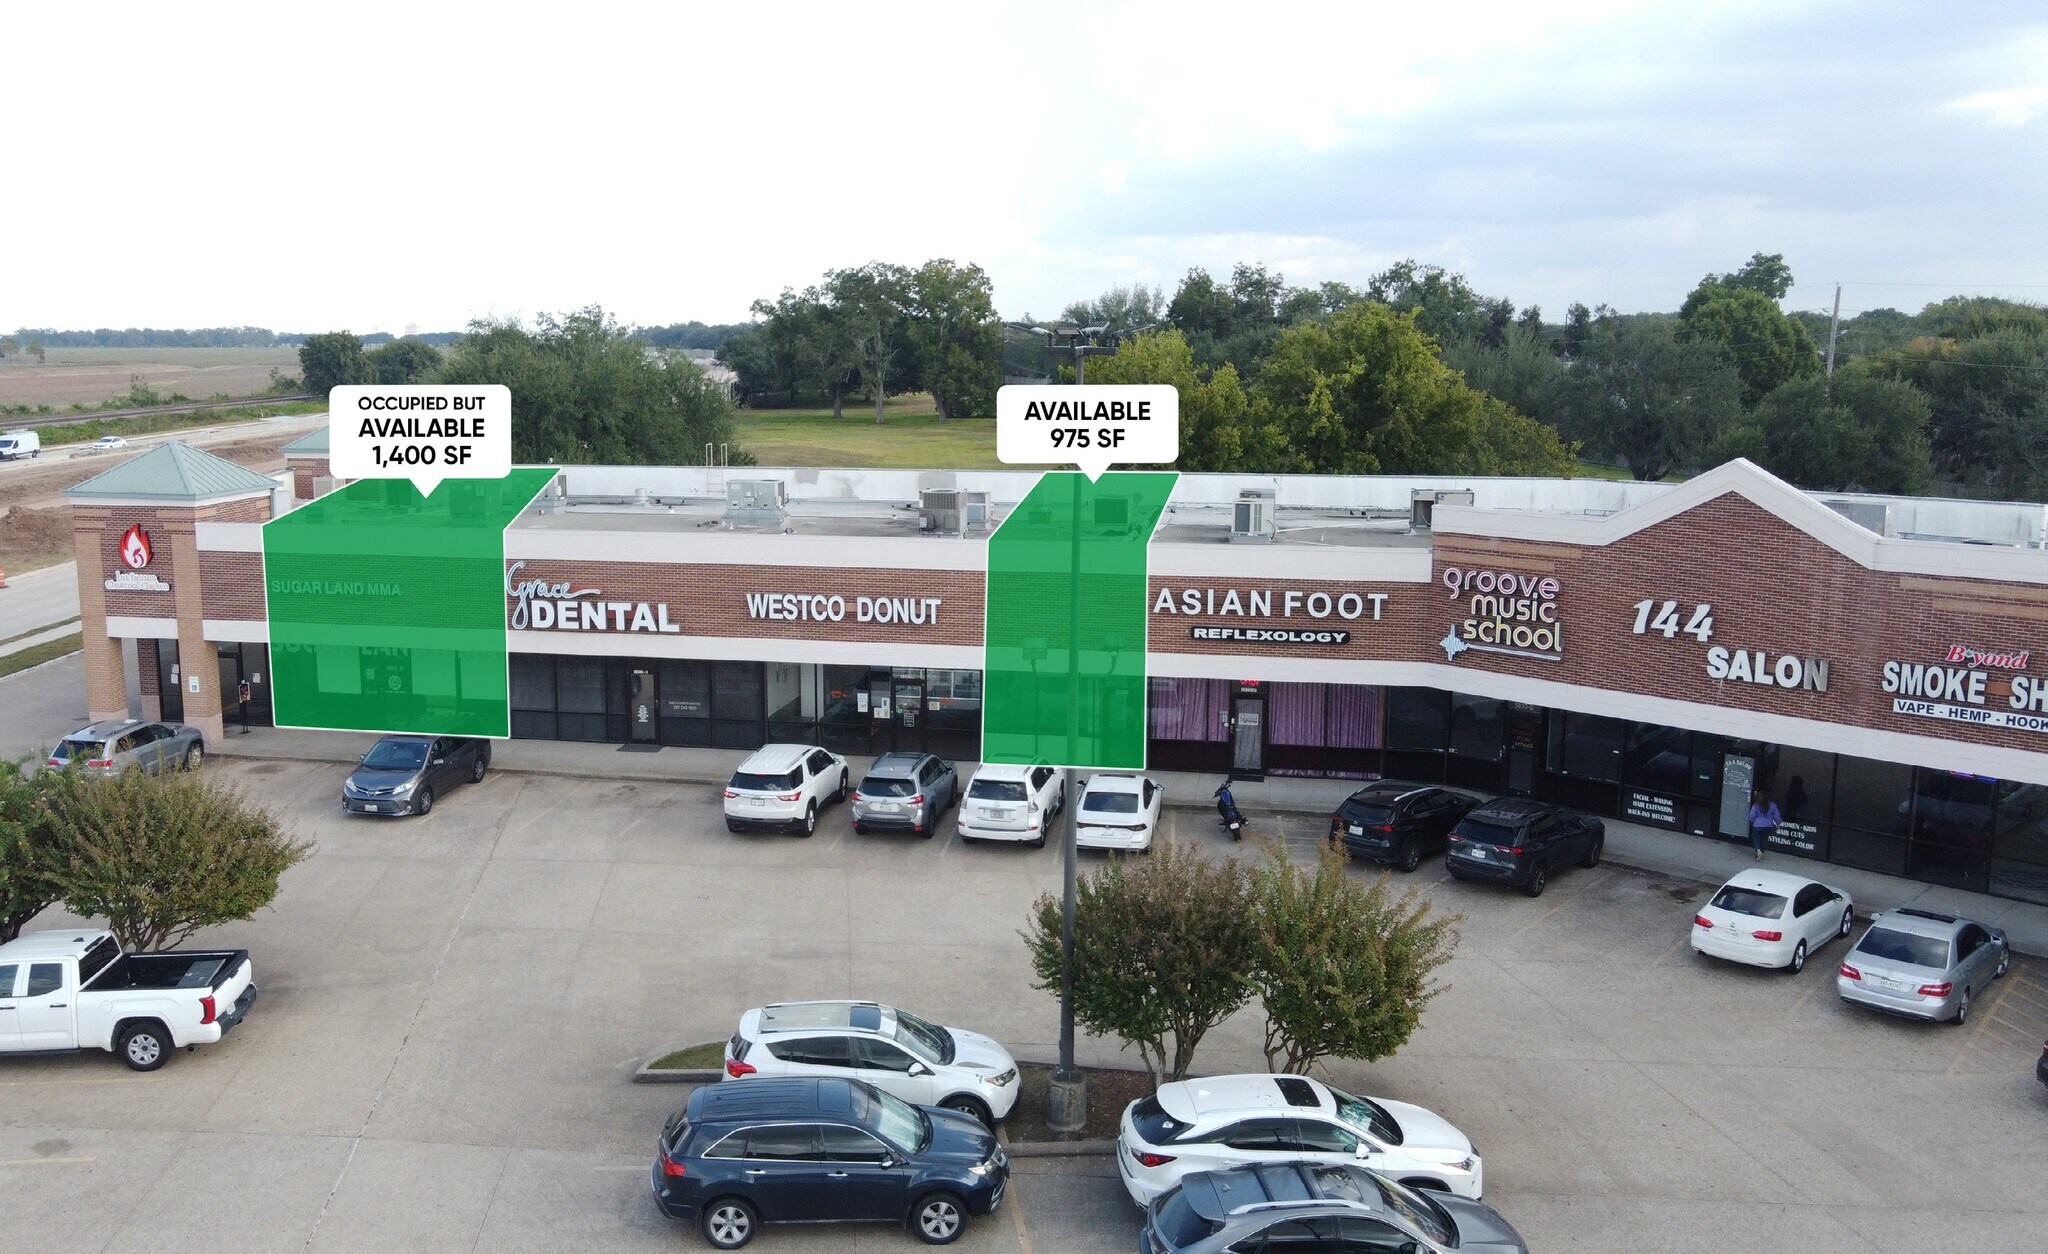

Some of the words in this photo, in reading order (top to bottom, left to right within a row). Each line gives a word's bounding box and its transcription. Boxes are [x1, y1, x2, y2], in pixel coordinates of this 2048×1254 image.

[271, 580, 322, 594] SUGAR
[325, 581, 364, 595] LAND
[367, 583, 402, 596] MMA
[506, 561, 600, 629] Grace
[1443, 567, 1560, 599] groove
[531, 600, 680, 632] DENTAL
[746, 593, 846, 622] WESTCO
[857, 597, 942, 624] DONUT
[1153, 587, 1271, 617] ASIAN
[1284, 591, 1388, 620] FOOT
[1471, 592, 1557, 623] music
[1193, 628, 1347, 643] REFLEXOLOGY
[1463, 615, 1562, 652] school
[1632, 600, 1714, 642] 144
[1706, 646, 1830, 692] SALON
[1881, 661, 1988, 705] SMOKE
[2009, 676, 2048, 713] SH
[1897, 700, 1935, 715] VAPE
[1948, 707, 1991, 722] HEMP
[1768, 835, 1791, 845] STYLING
[1794, 840, 1815, 850] COLOR
